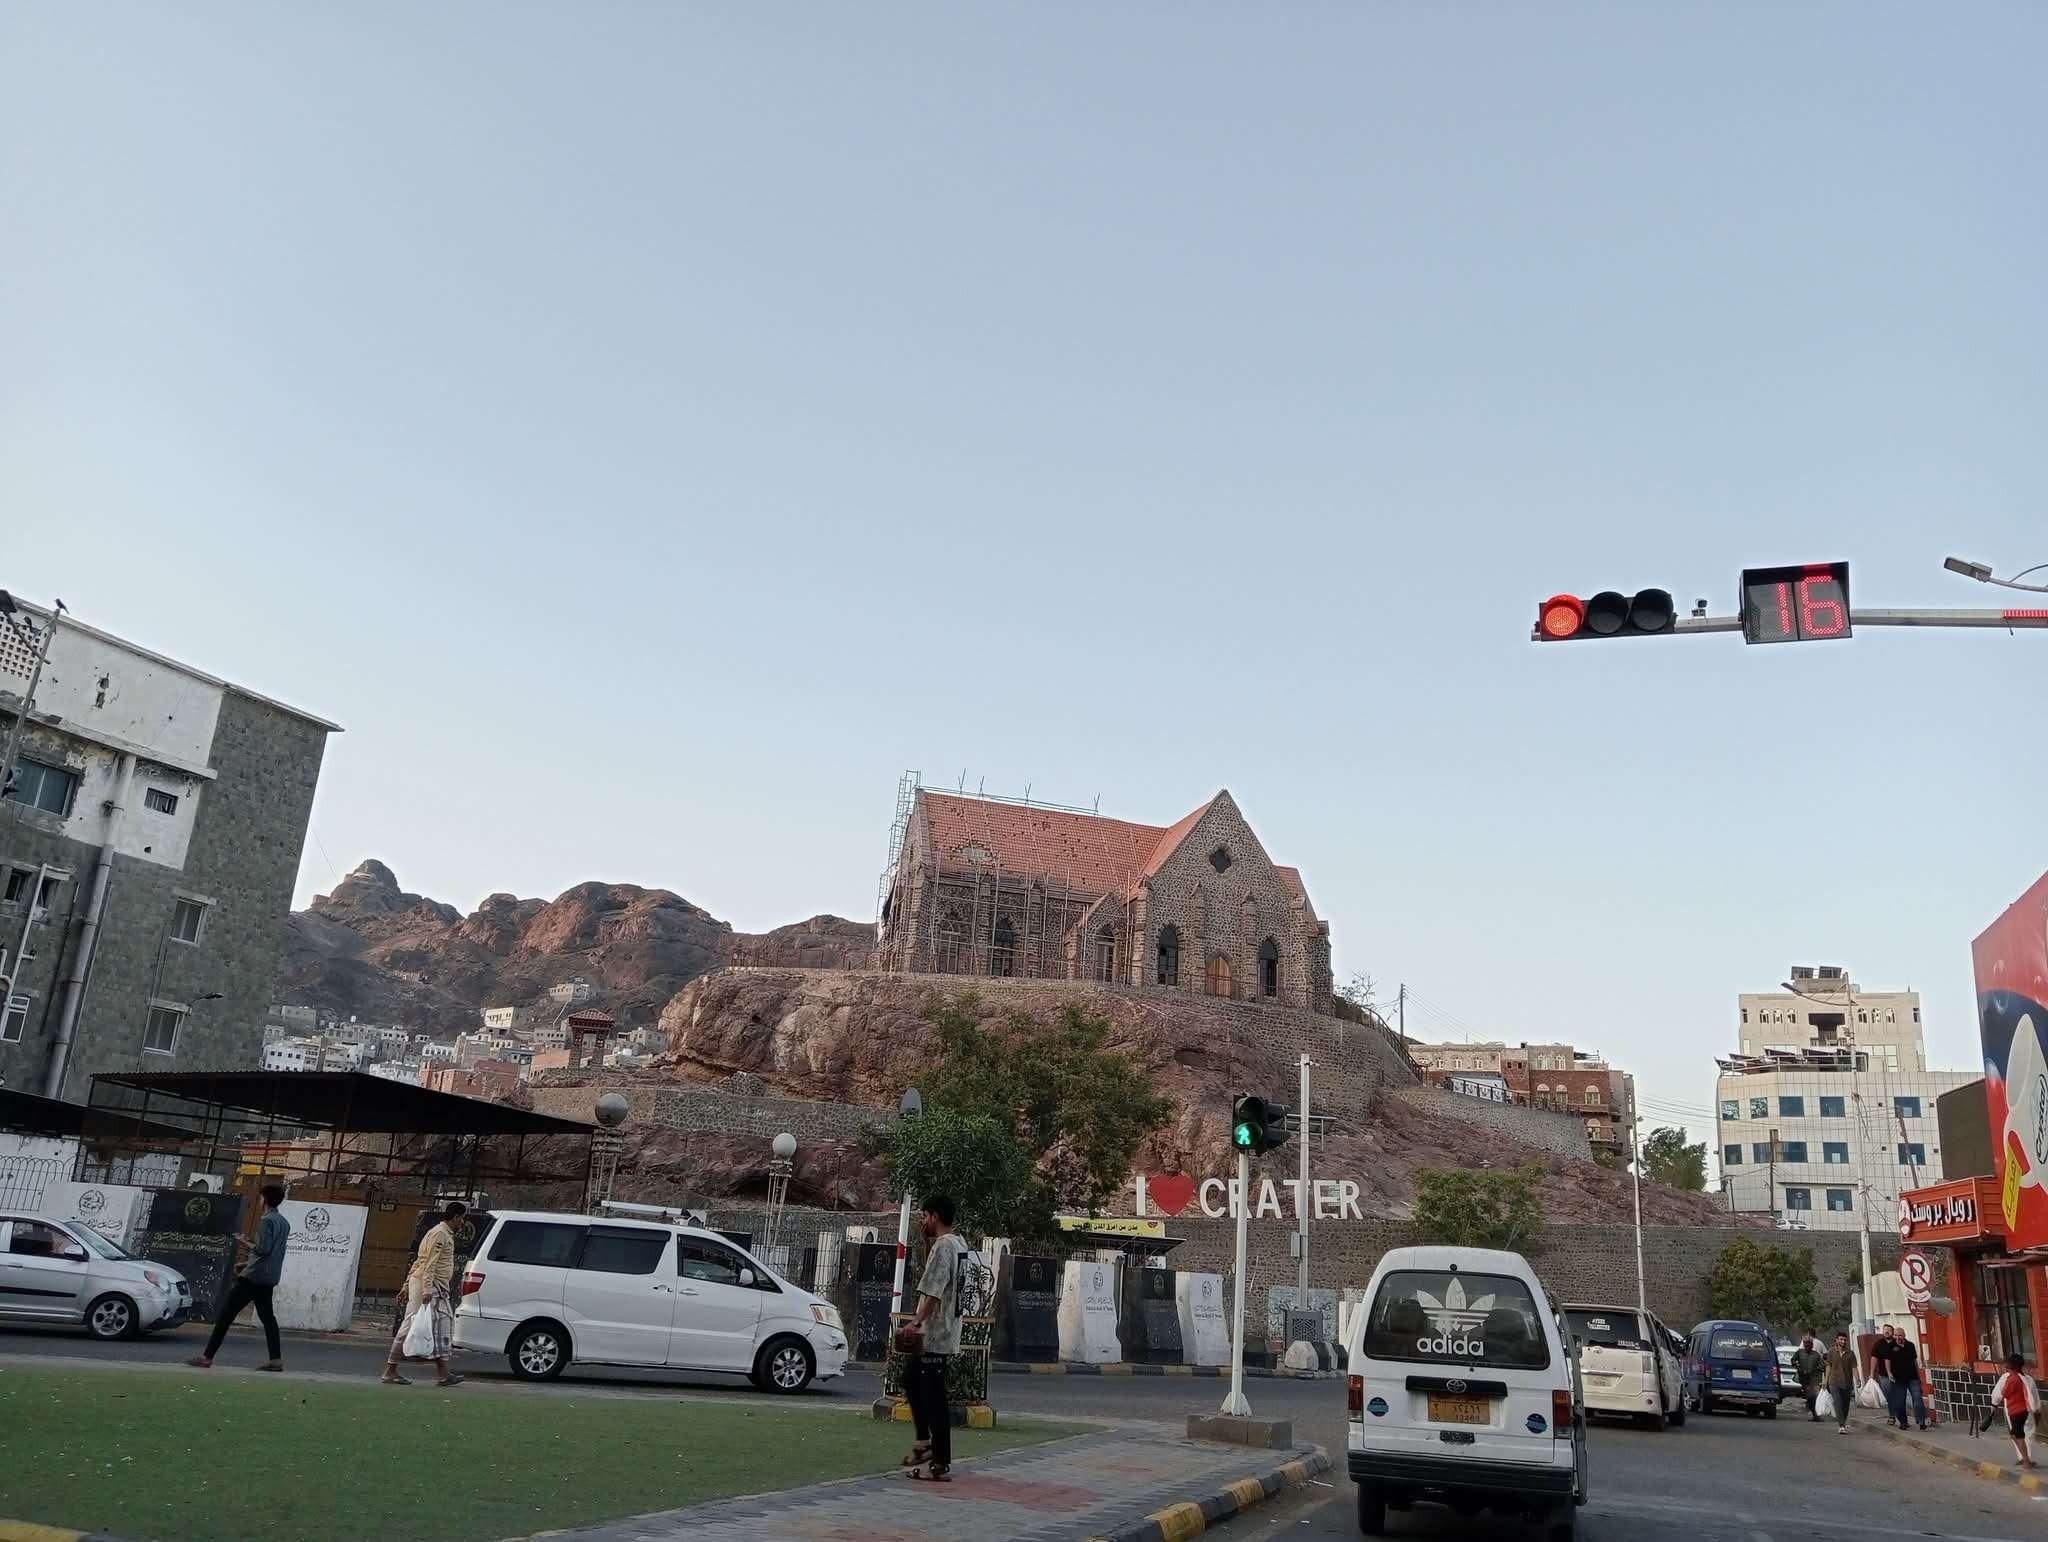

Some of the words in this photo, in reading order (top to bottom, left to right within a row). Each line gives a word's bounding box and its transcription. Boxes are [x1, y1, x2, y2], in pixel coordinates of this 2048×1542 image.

[1778, 576, 1842, 635] 16
[2035, 1080, 2046, 1159] Crystal
[1135, 1176, 1146, 1217] I
[1200, 1177, 1364, 1220] CRATER
[1944, 1195, 1973, 1225] رويال
[1911, 1203, 1943, 1227] بروست
[1908, 1258, 1926, 1285] P
[1416, 1334, 1484, 1357] adida
